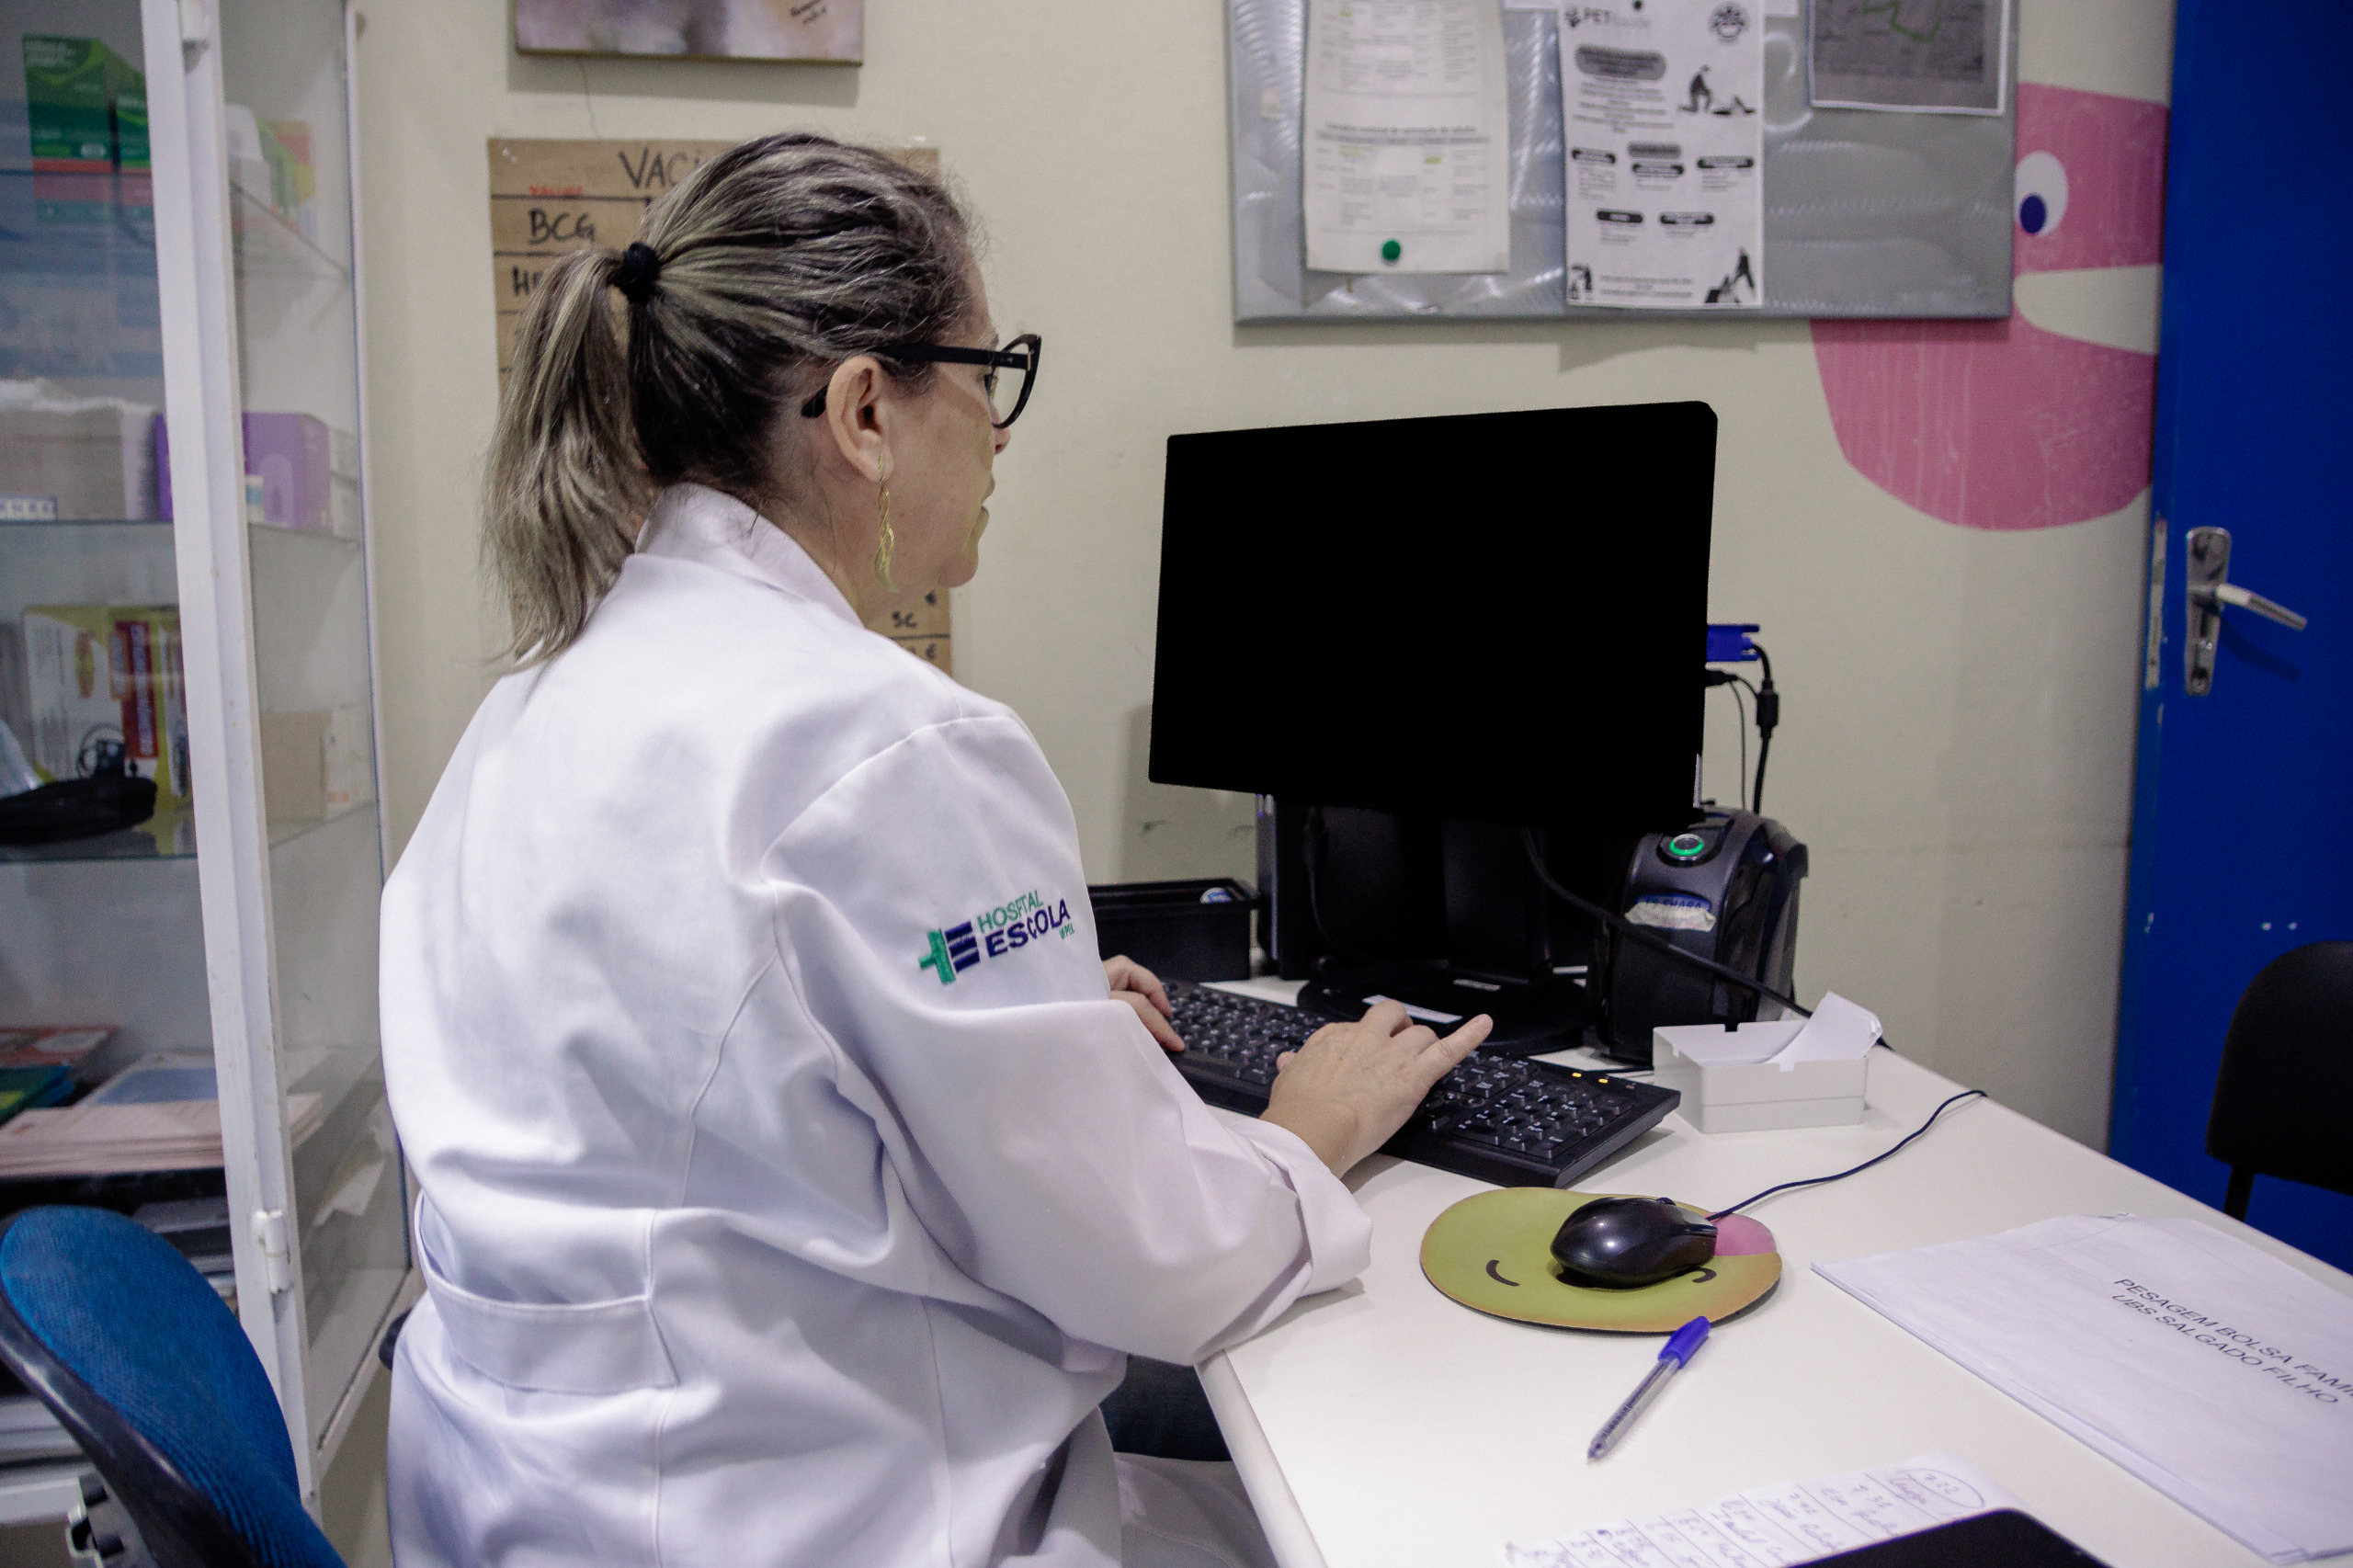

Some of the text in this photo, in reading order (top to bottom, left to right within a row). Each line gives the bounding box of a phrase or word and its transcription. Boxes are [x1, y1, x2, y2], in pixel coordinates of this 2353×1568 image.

[529, 209, 596, 244] BCG
[985, 899, 1071, 958] ESCOLA
[2112, 1294, 2338, 1403] UBS SALGADO FILHO
[2114, 1278, 2353, 1397] PESAGEM BOLSA FAMI
